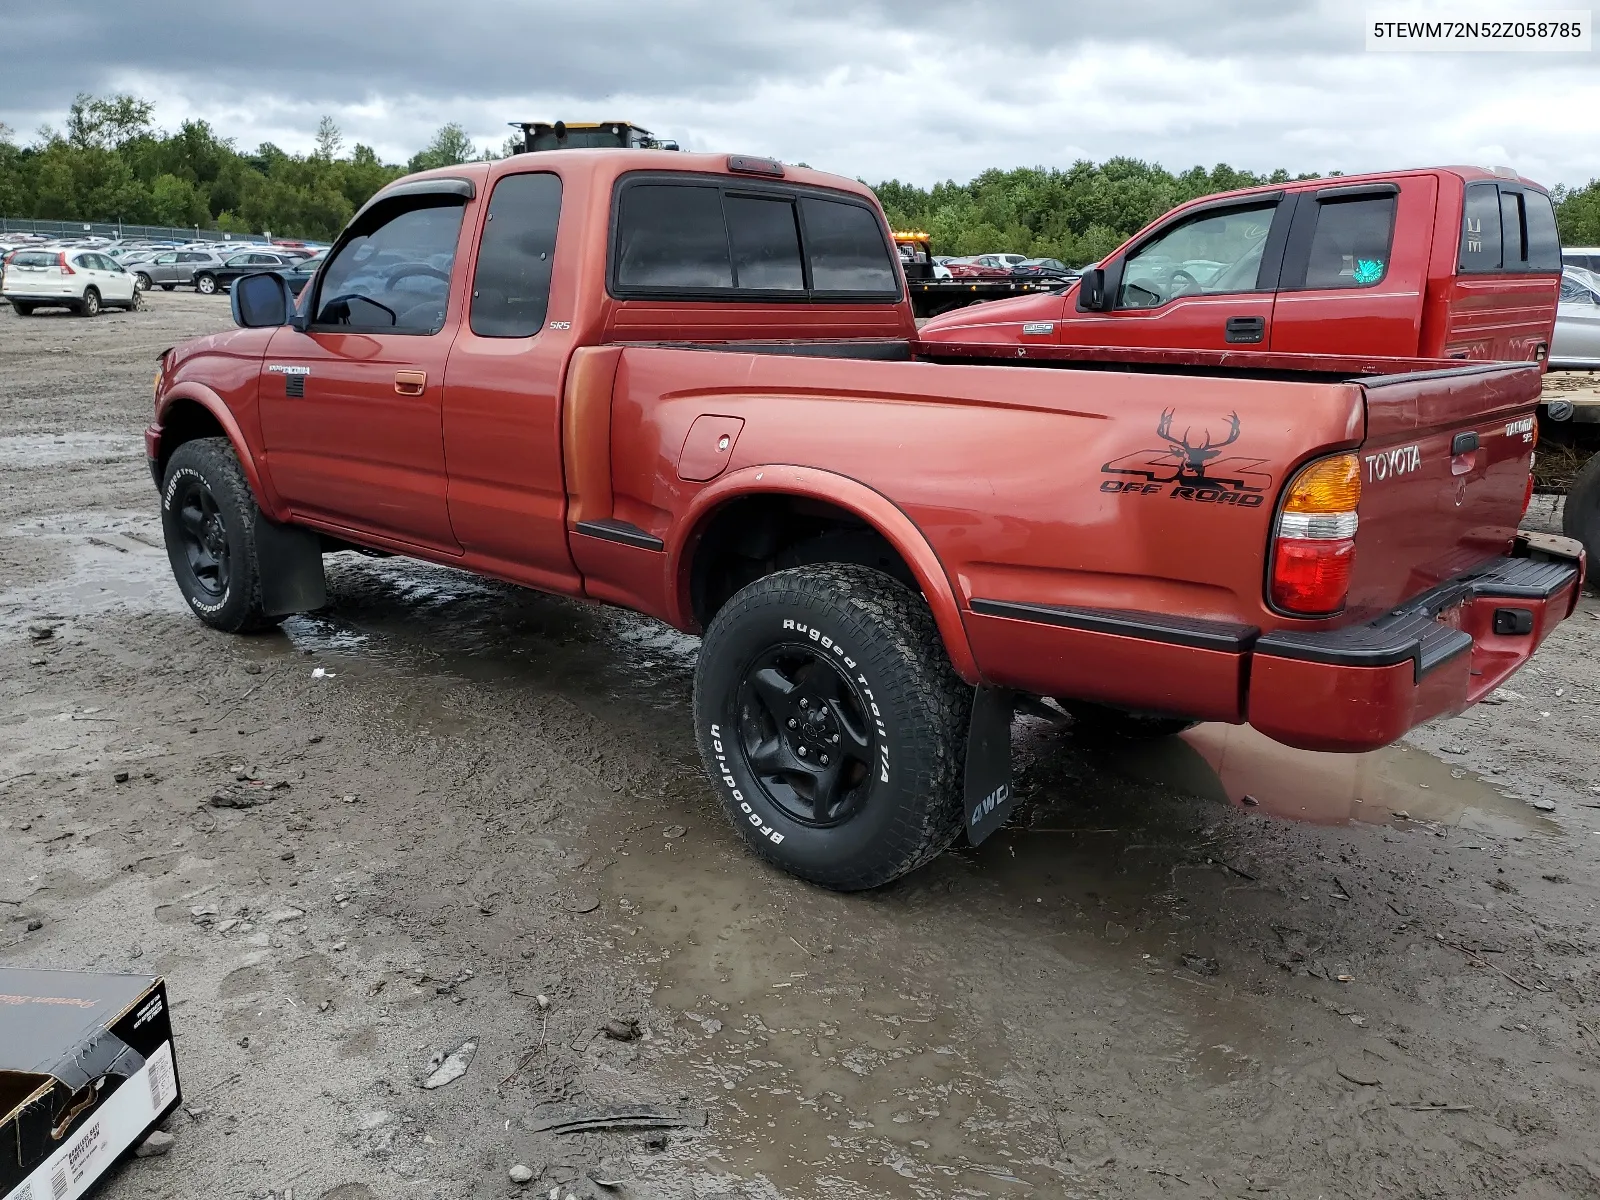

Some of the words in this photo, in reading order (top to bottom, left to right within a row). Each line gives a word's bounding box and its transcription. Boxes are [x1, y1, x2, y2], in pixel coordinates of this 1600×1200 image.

[1366, 445, 1422, 483] TOYOTA
[1100, 480, 1163, 496] OFF
[1169, 486, 1265, 508] ROAD
[783, 618, 857, 669] Rugged
[857, 673, 887, 737] Trail
[880, 744, 890, 783] T/A
[710, 724, 785, 845] BFGoodrich
[971, 783, 1009, 827] 4WD
